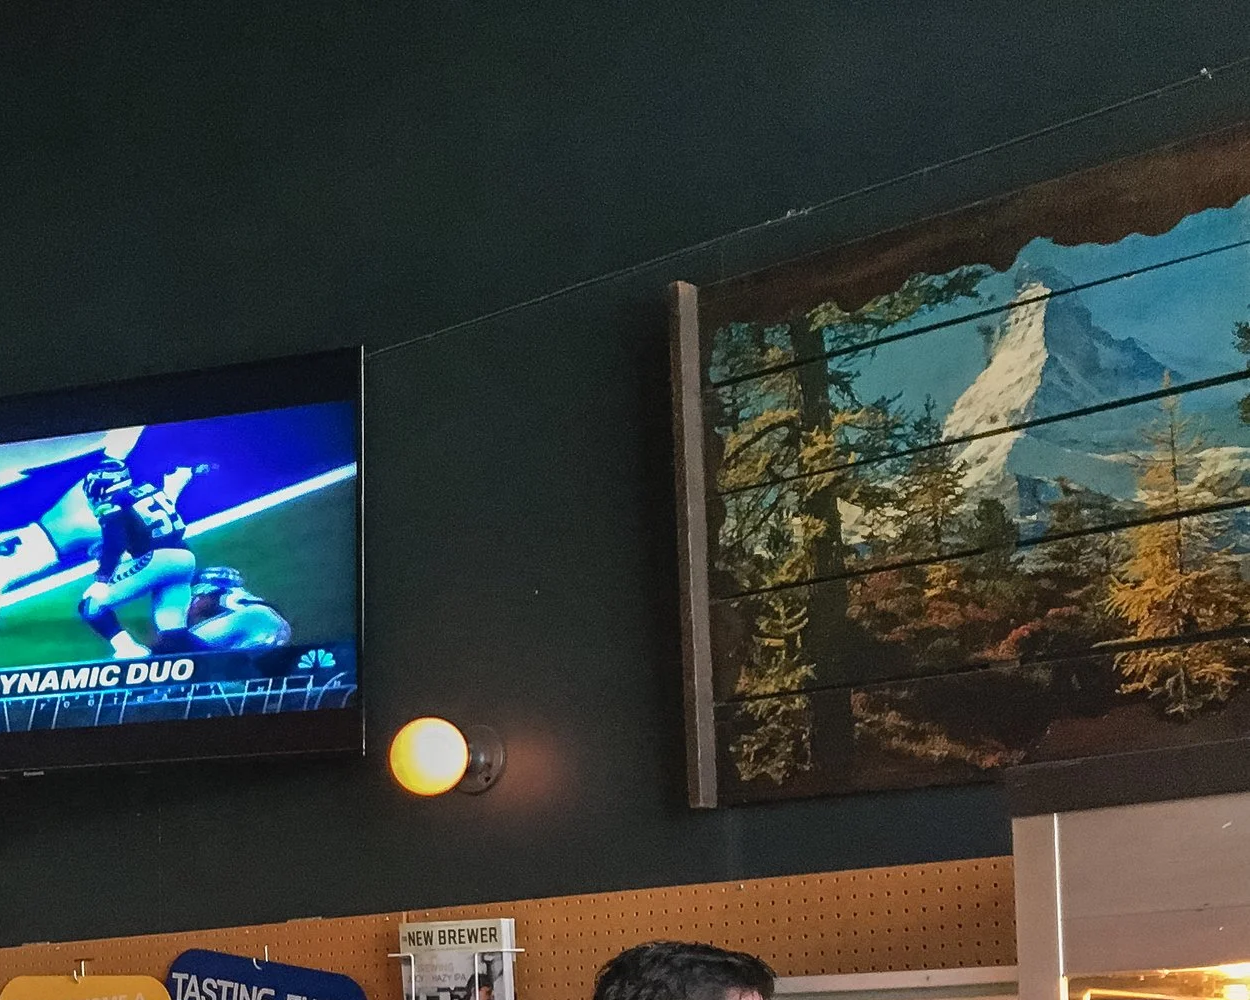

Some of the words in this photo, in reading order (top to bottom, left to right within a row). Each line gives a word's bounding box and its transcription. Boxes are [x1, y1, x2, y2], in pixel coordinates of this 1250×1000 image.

[125, 658, 195, 685] DUO
[408, 931, 433, 946] NEW
[438, 927, 498, 945] BREWER
